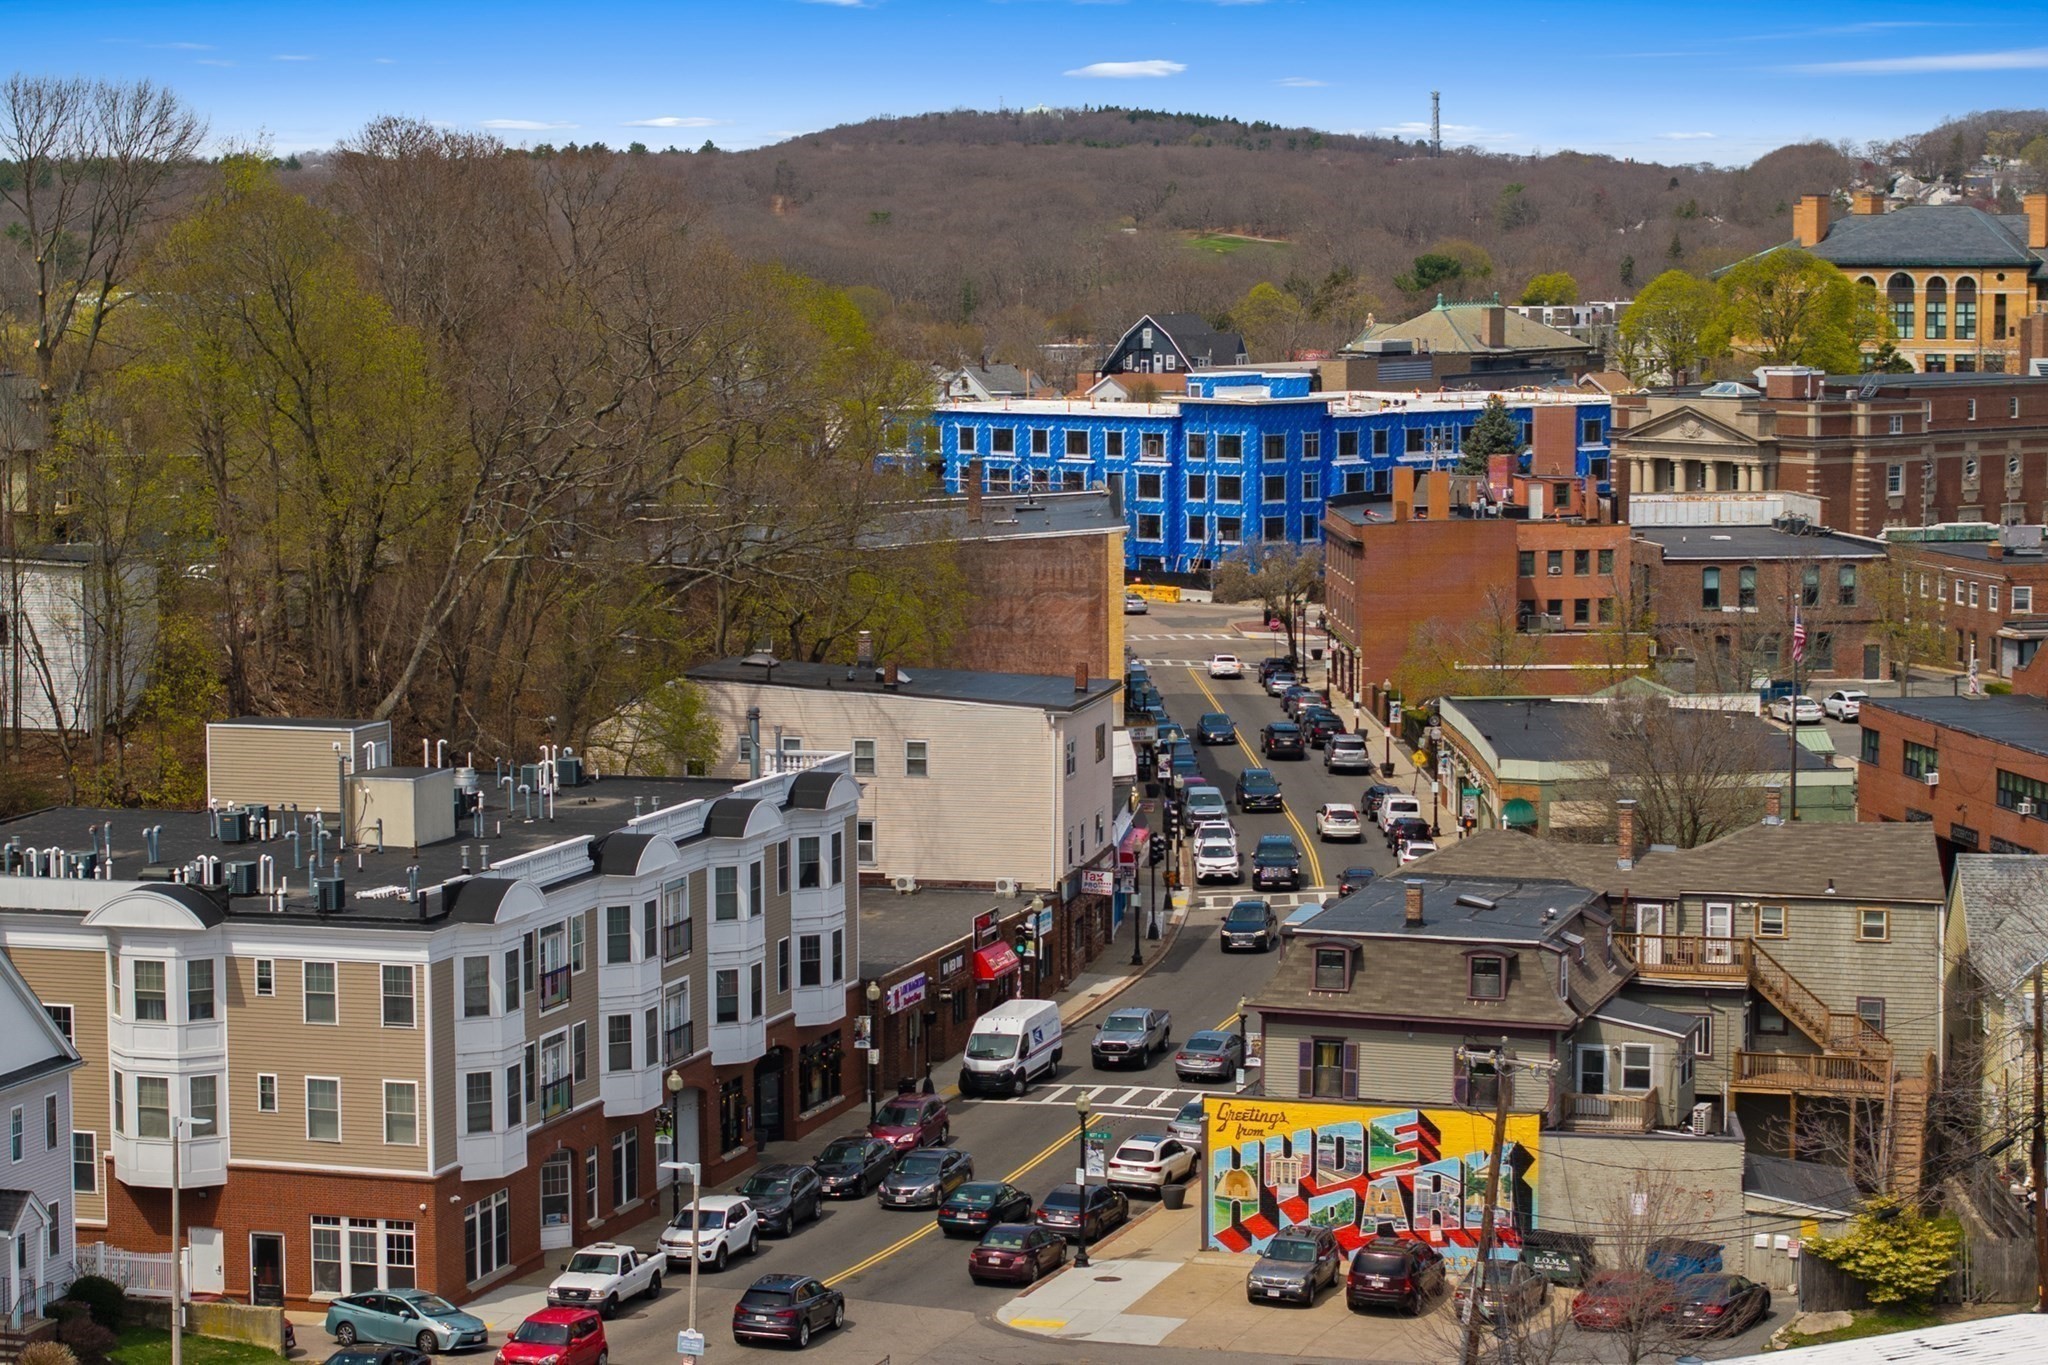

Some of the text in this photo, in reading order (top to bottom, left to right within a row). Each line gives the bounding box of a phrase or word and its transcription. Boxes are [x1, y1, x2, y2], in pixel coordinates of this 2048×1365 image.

[1084, 870, 1104, 882] Tax
[1216, 1102, 1289, 1132] Greetings
[1235, 1123, 1265, 1140] from
[1213, 1109, 1419, 1237] HYDE
[1308, 1141, 1517, 1238] PARK
